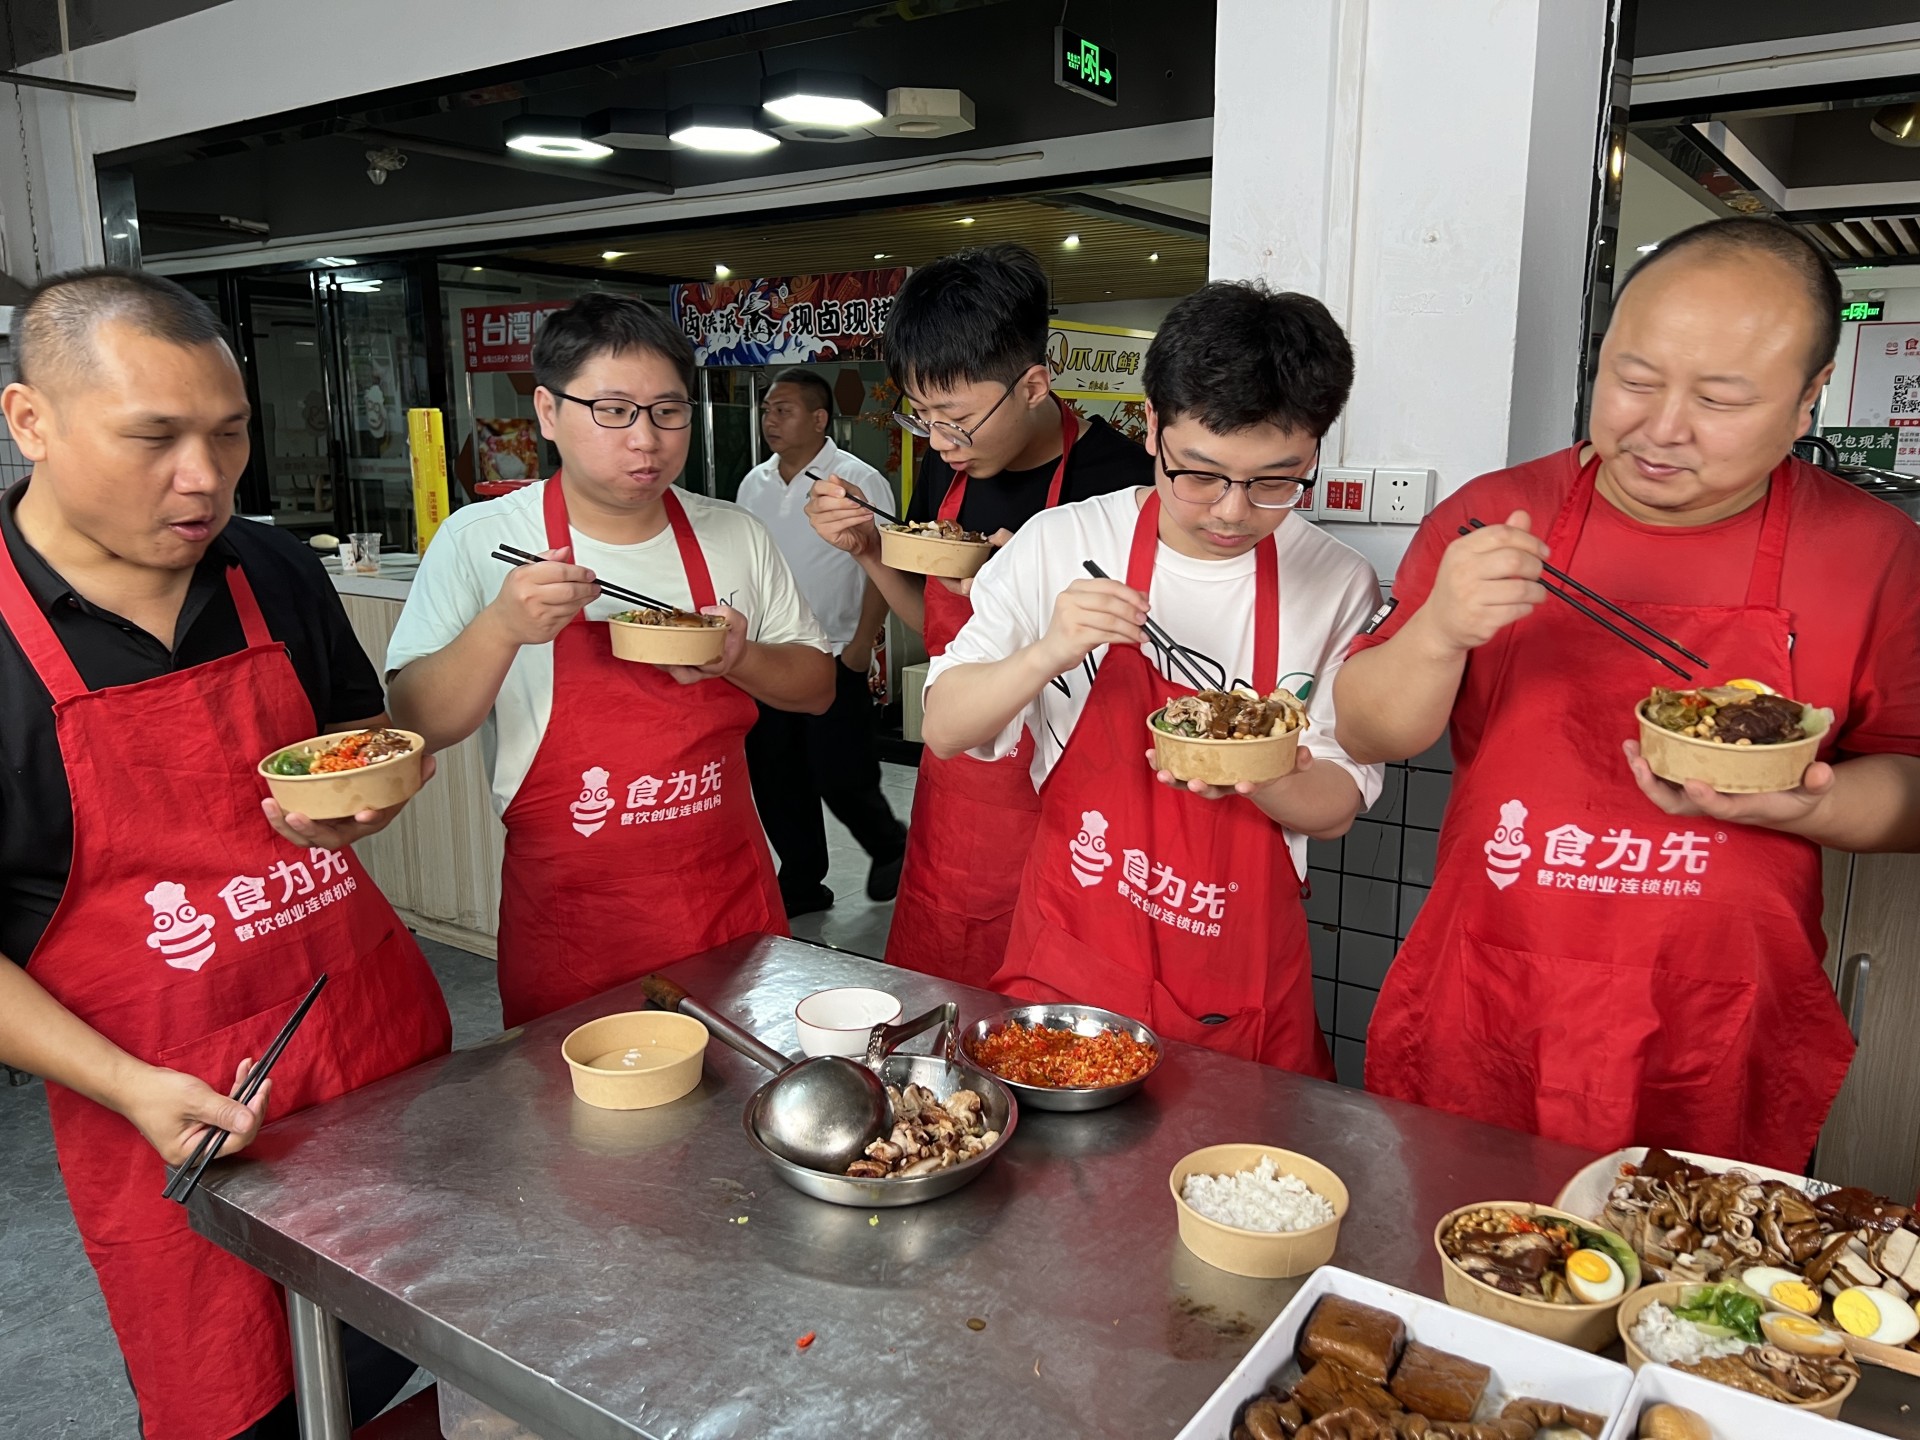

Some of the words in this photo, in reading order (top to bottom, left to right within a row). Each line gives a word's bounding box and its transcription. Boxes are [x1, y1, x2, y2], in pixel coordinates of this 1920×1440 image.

[1067, 347, 1140, 375] 爪爪鲜
[1826, 432, 1895, 449] 现包现煮
[626, 761, 722, 809] 食为先
[621, 794, 722, 826] 餐饮创业连锁机构
[1544, 823, 1711, 874] 食为先
[217, 846, 349, 921] 食为先
[1122, 848, 1226, 919] 食为先
[1536, 869, 1702, 896] 餐饮创业连锁机构
[234, 876, 357, 943] 餐饮创业连锁机构
[1117, 879, 1221, 937] 餐饮创业连锁机构
